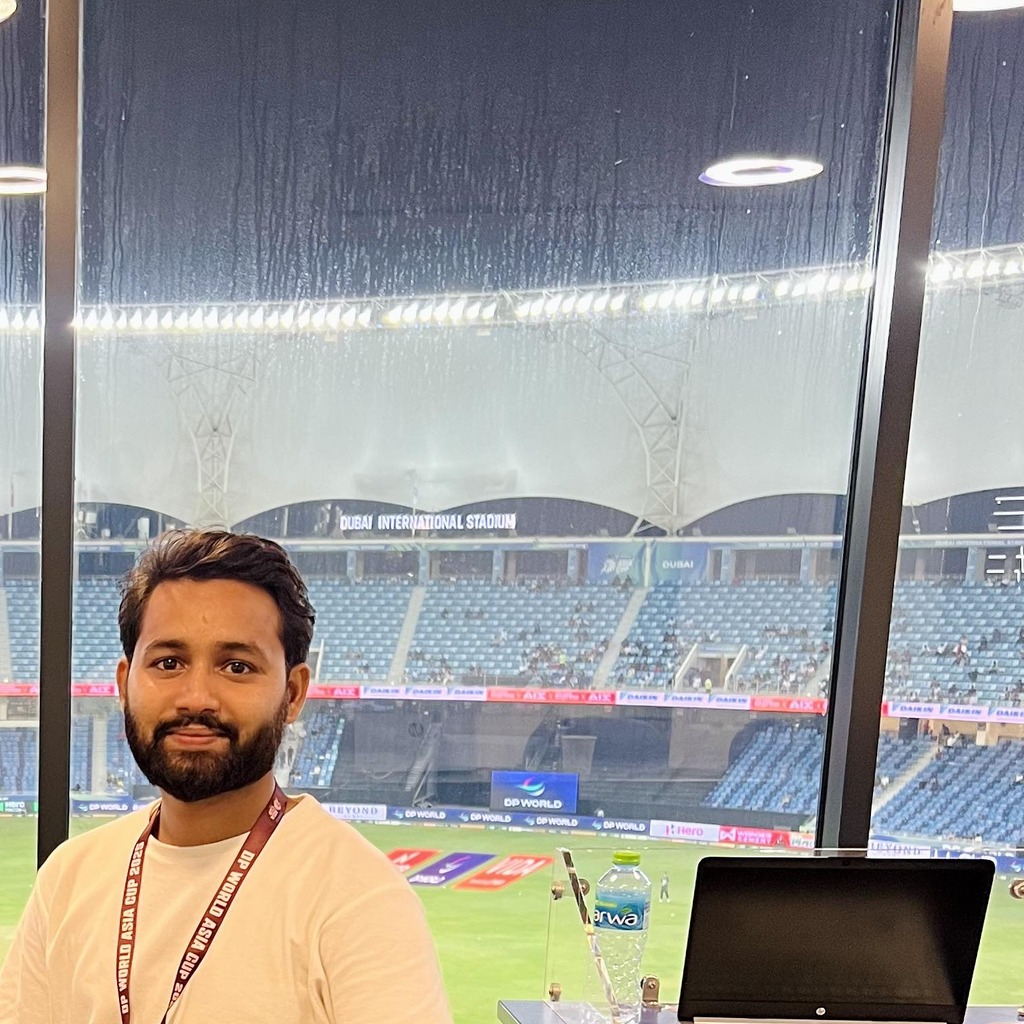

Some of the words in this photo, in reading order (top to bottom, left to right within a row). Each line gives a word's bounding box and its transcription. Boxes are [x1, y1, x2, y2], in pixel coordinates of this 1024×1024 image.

[340, 514, 372, 530] DUBAI
[378, 513, 464, 530] INTERNATIONAL
[466, 512, 516, 530] STADIUM
[662, 560, 694, 569] DUBAI
[330, 806, 378, 814] BEYOND
[504, 798, 520, 807] DP
[521, 799, 563, 808] WORLD
[405, 810, 416, 818] DP
[417, 810, 446, 820] WORLD
[470, 814, 482, 822] DP
[482, 814, 512, 823] WORLD
[536, 817, 548, 825] DP
[548, 818, 578, 827] WORLD
[604, 821, 616, 830] DP
[616, 822, 646, 832] WORLD
[677, 826, 704, 836] Hero
[238, 850, 256, 870] DP
[124, 879, 138, 905] CUP
[209, 871, 244, 917] WORLD
[121, 908, 135, 940] ASIA
[594, 909, 638, 926] arwa
[190, 918, 216, 950] ASIA
[118, 944, 131, 992] WORLD
[179, 952, 199, 980] CUP
[121, 996, 128, 1014] DP
